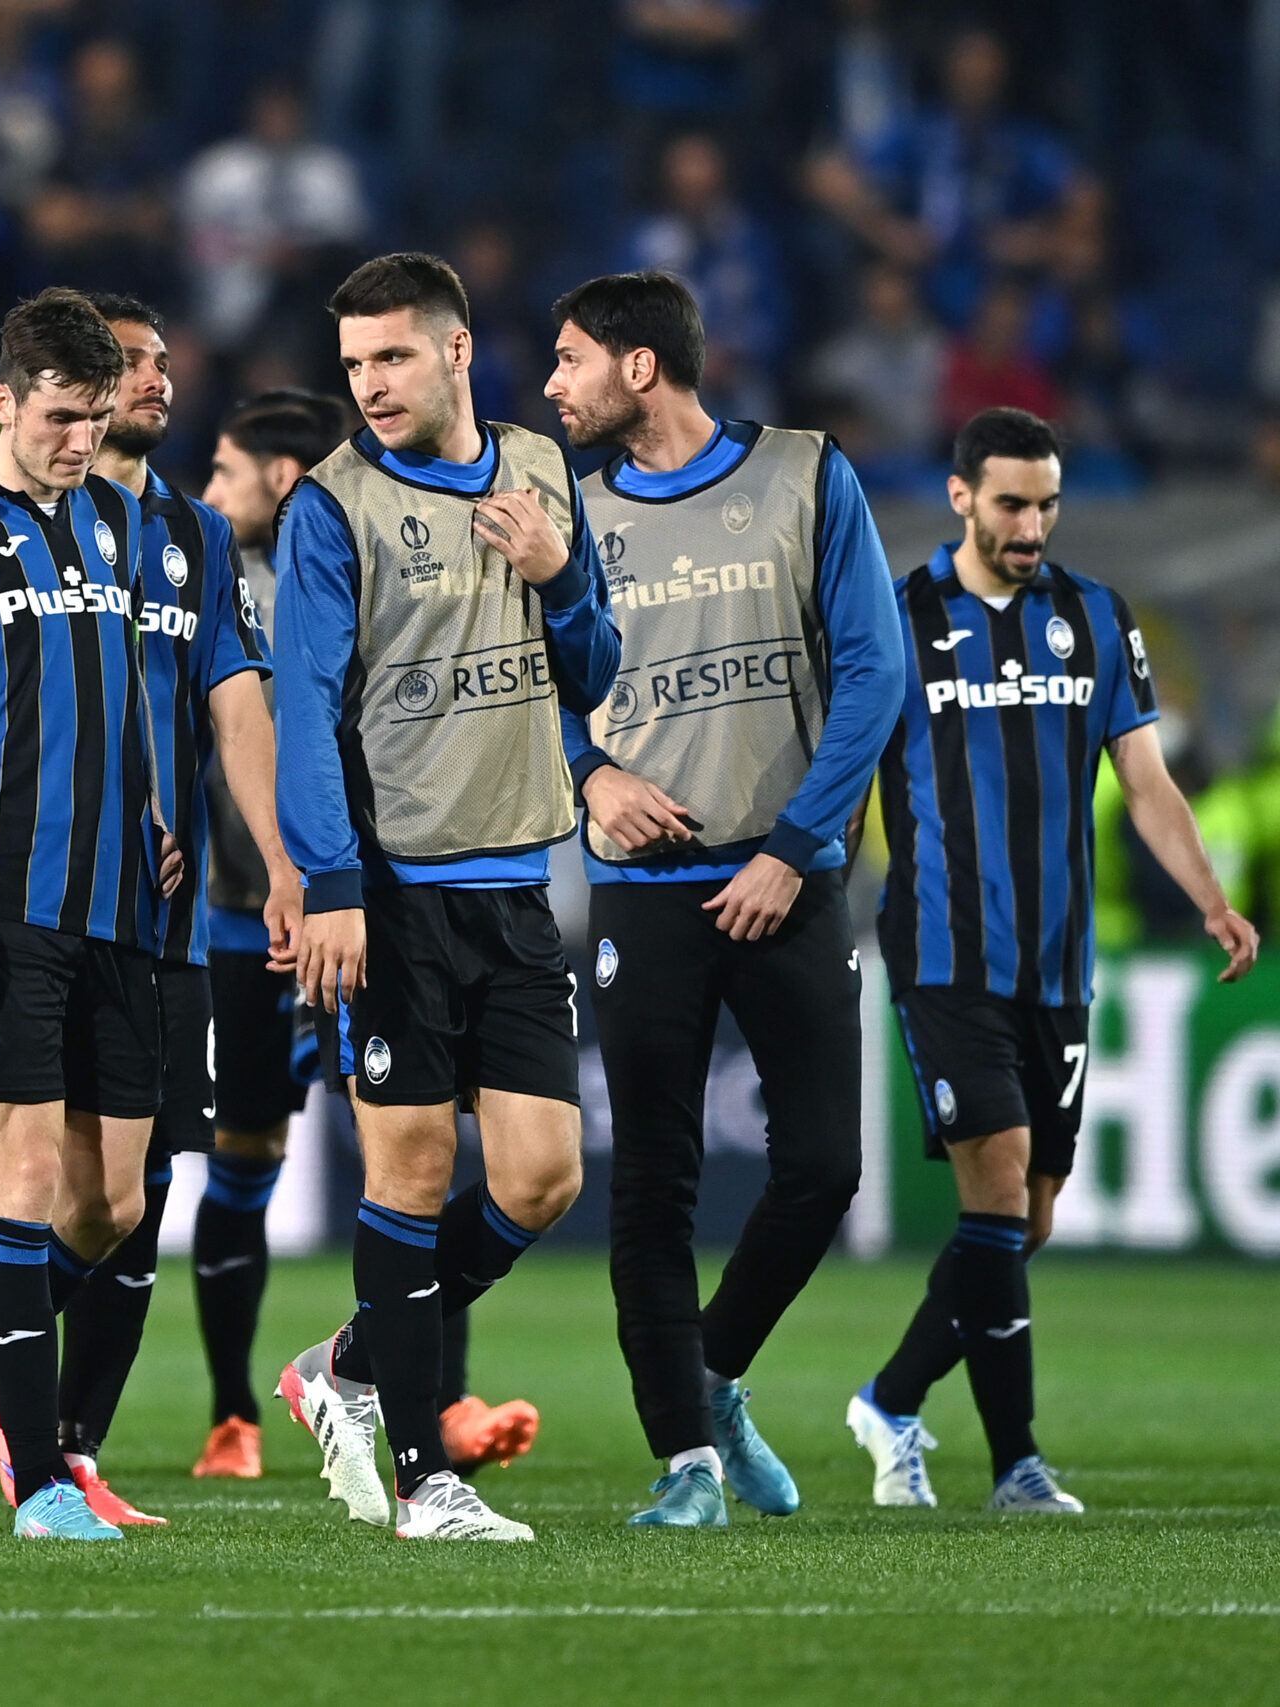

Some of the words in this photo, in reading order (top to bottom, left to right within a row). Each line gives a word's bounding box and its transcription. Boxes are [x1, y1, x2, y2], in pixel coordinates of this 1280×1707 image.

[400, 562, 444, 579] EUROPA
[452, 652, 548, 701] RESPE
[651, 651, 802, 708] RESPECT
[925, 675, 1095, 714] Plus500
[399, 1447, 419, 1467] 19
